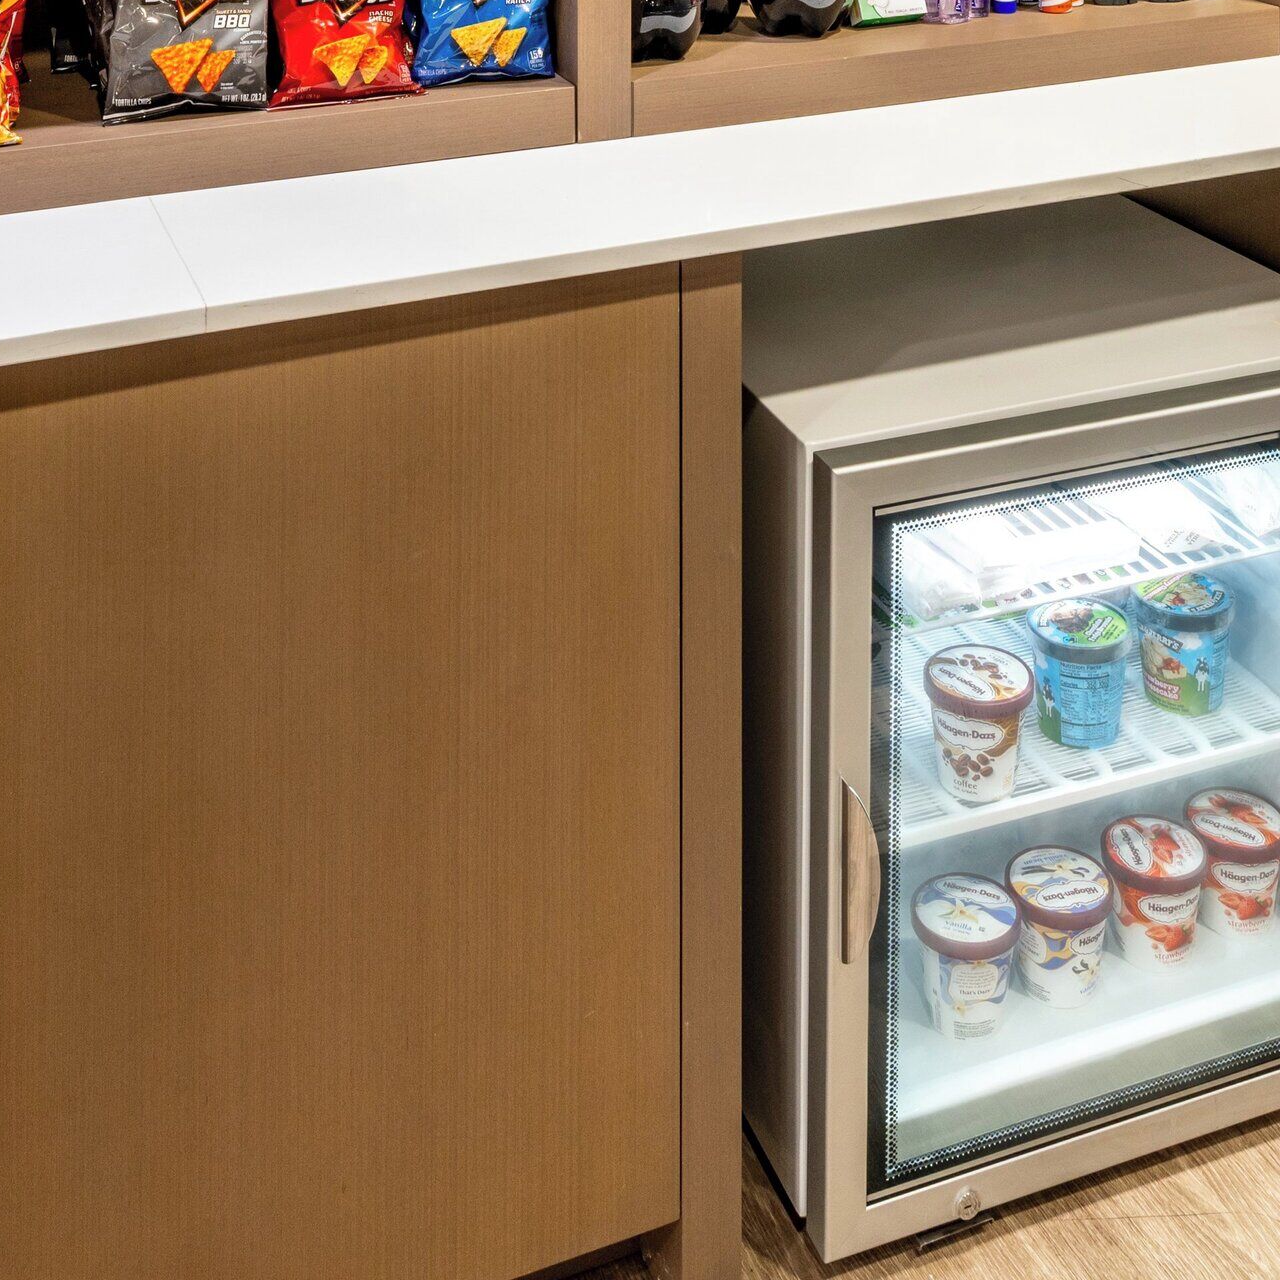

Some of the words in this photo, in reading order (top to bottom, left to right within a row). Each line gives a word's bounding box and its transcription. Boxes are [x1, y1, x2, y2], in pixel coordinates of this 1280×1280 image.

[213, 14, 251, 29] BBQ
[937, 716, 996, 742] Häagen-Dazs
[953, 777, 978, 790] coffee
[1220, 869, 1276, 884] Häagen-Dazs
[943, 881, 1001, 901] Häagen-Dazs
[1042, 886, 1099, 902] Häagen-Dazs
[945, 919, 972, 932] vanilla
